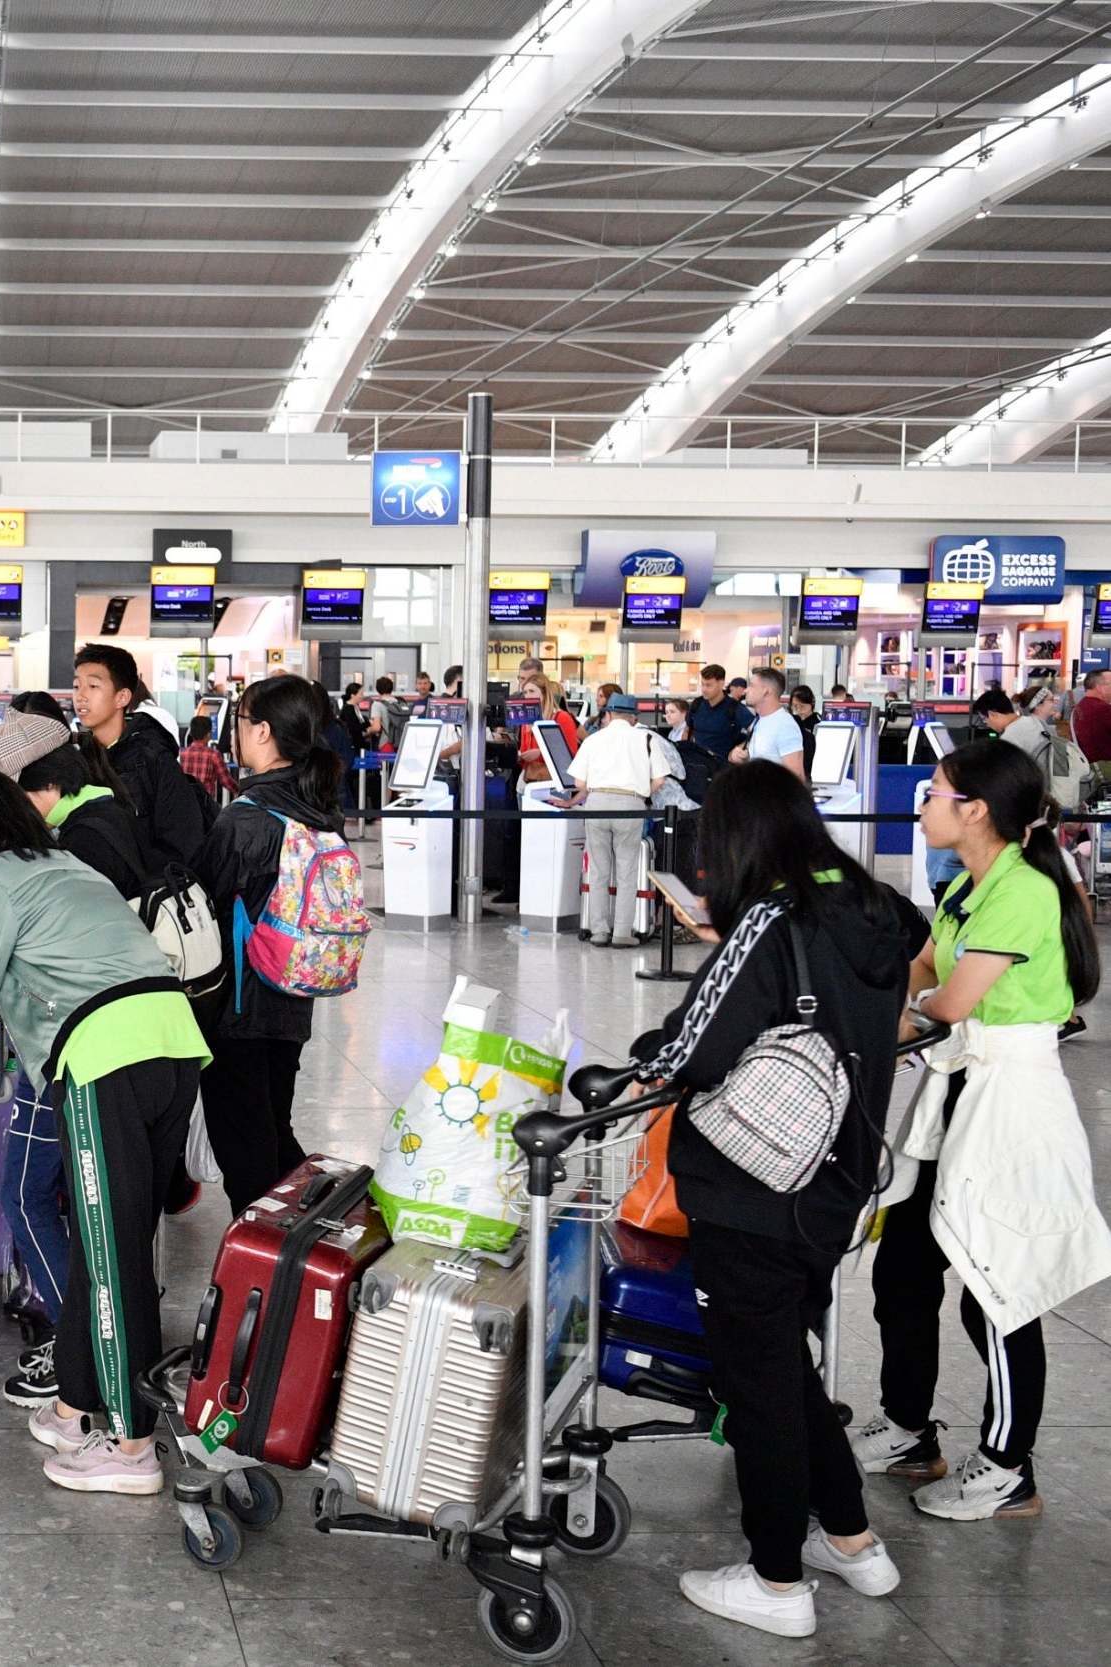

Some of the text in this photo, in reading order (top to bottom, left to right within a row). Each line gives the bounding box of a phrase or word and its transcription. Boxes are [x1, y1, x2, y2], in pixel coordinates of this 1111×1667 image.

[181, 540, 207, 549] North
[1001, 554, 1056, 566] EXCESS
[1001, 567, 1056, 576] BAGGAGE
[1001, 577, 1056, 587] COMPANY
[399, 1216, 451, 1239] ASDA
